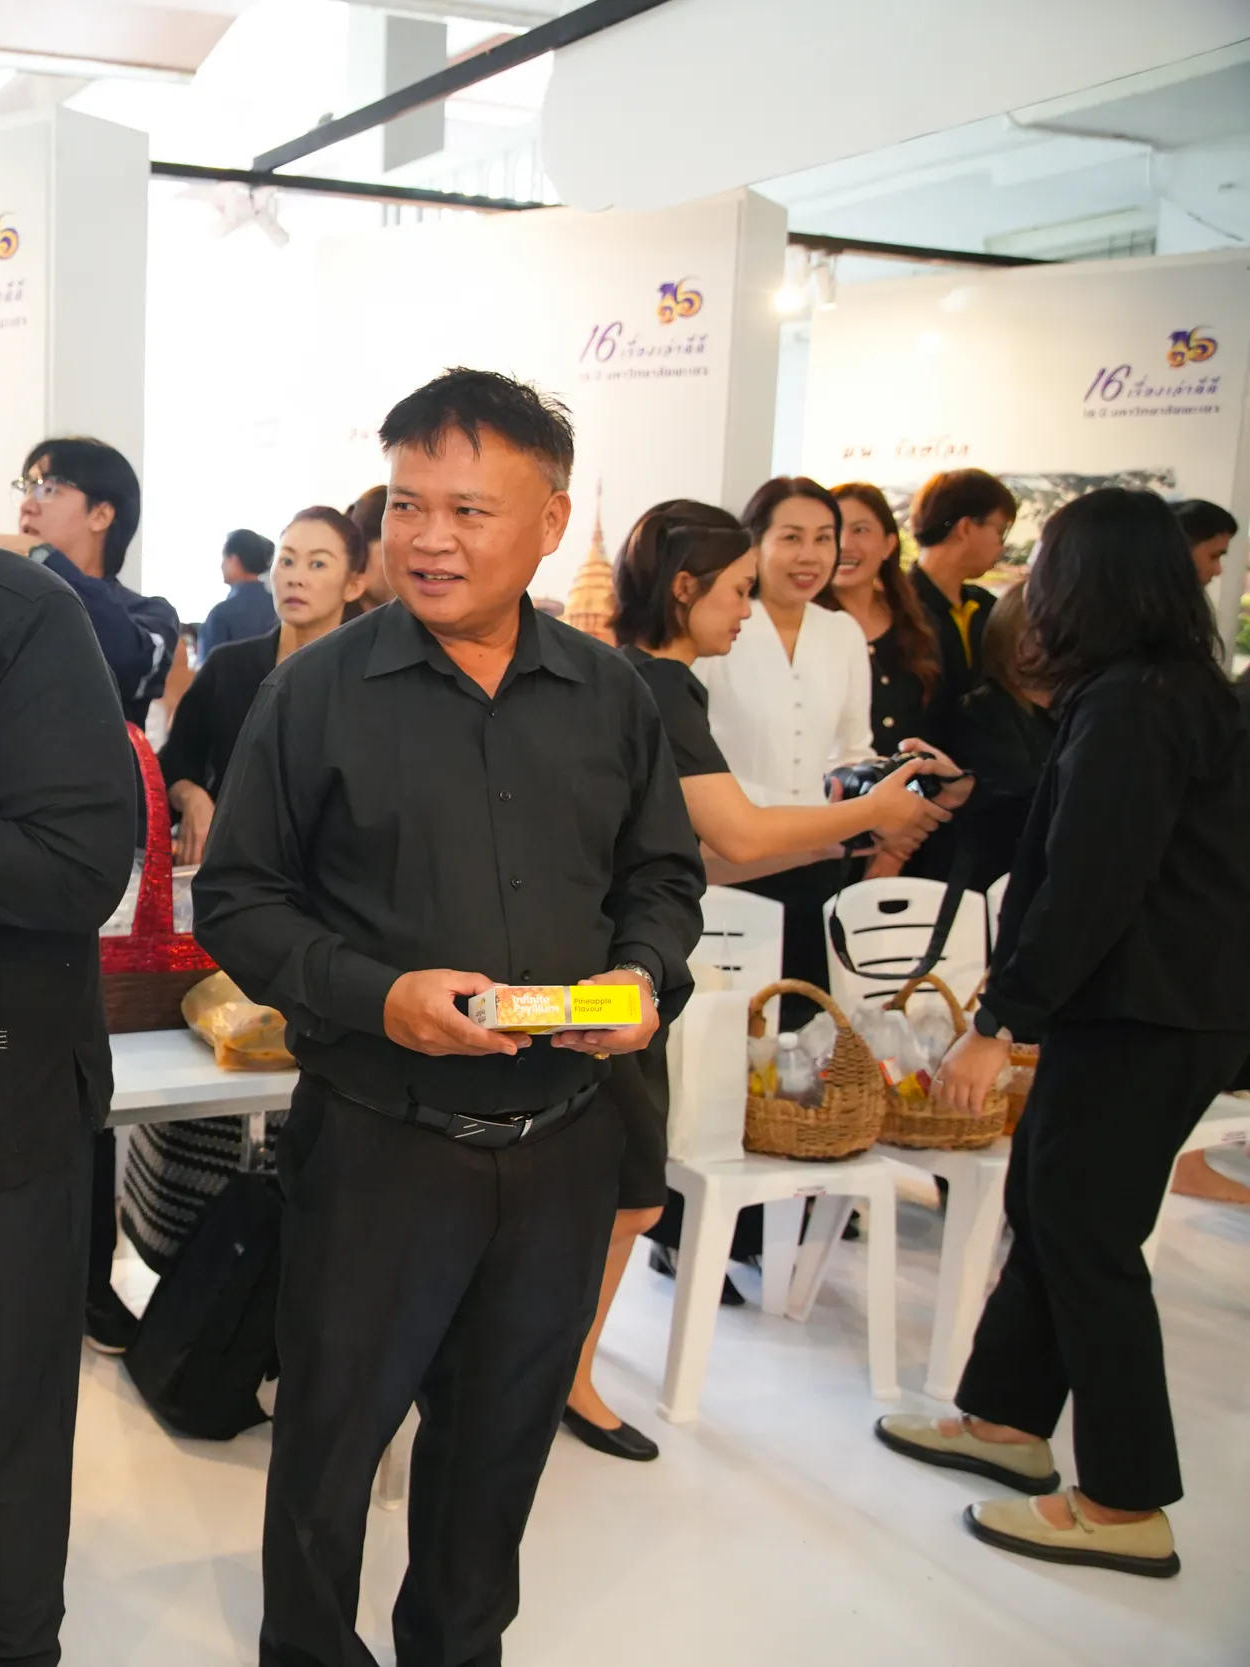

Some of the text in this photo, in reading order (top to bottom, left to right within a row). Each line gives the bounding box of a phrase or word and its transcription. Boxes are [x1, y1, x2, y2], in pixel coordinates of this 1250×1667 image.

[580, 321, 623, 363] 16
[1083, 363, 1132, 402] 16
[513, 994, 550, 1005] Infinite
